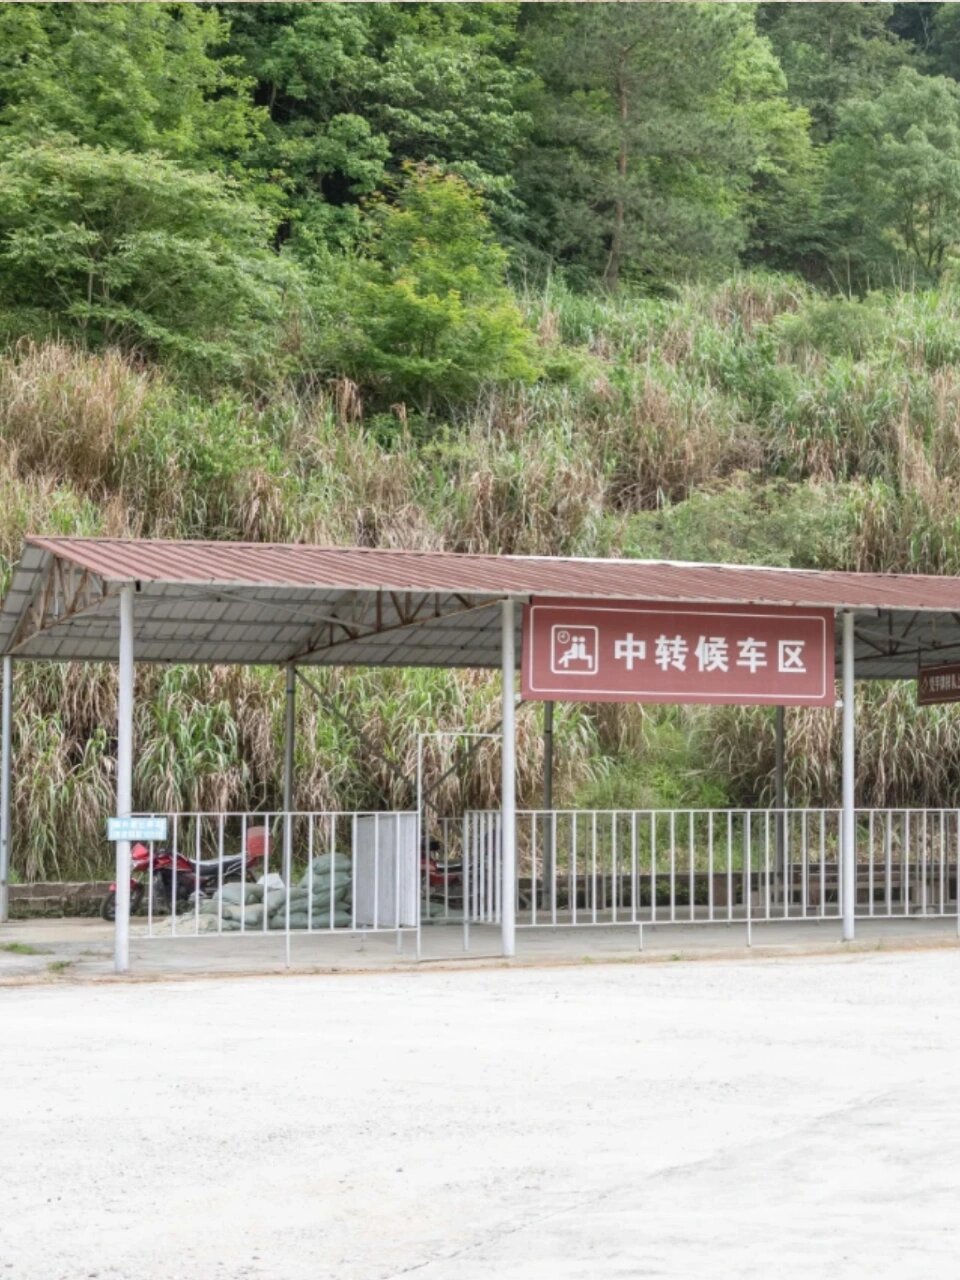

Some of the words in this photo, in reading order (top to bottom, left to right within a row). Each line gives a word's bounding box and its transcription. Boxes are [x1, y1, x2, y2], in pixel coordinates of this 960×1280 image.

[614, 632, 807, 673] 中转候车区
